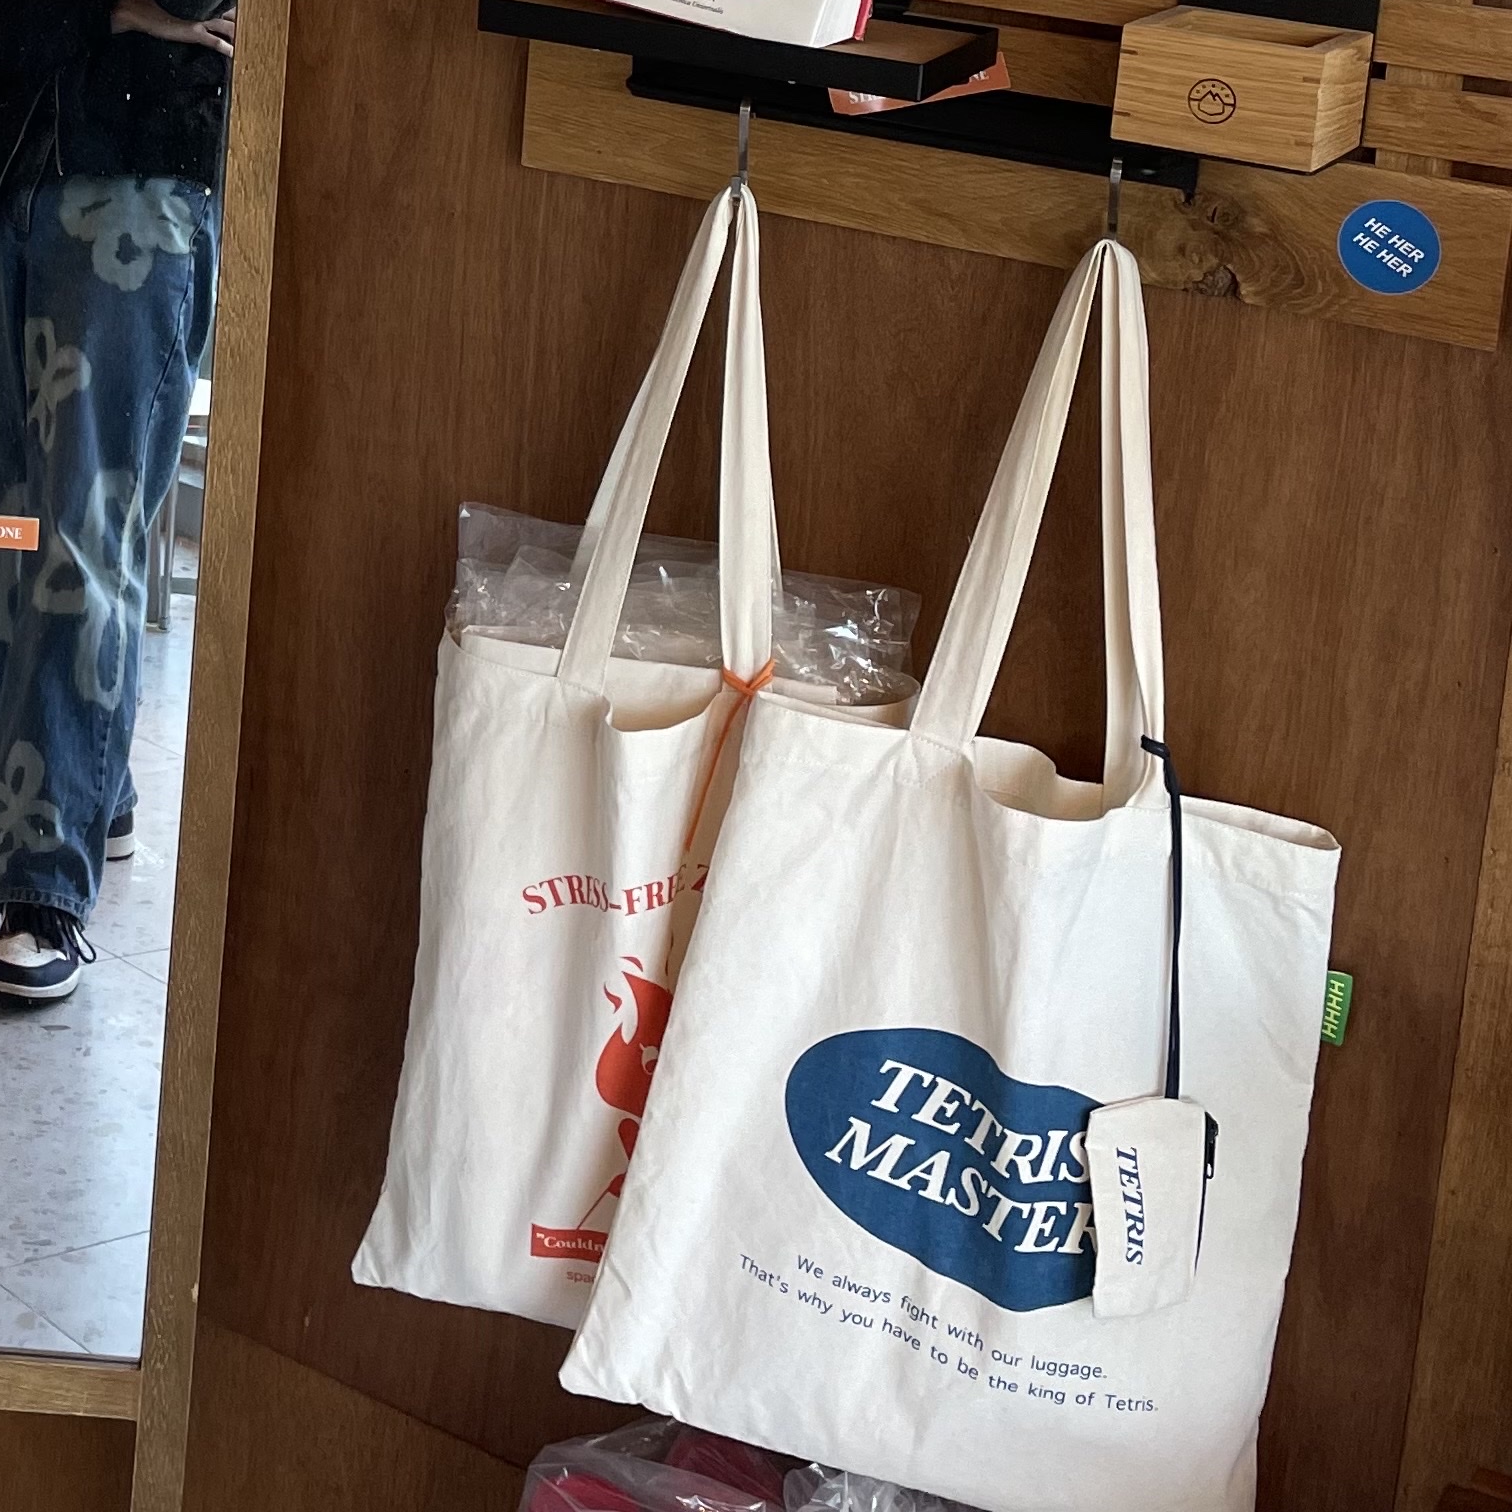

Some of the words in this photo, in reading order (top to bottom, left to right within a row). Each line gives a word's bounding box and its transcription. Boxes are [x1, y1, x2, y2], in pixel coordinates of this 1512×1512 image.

[1352, 232, 1380, 254] HE
[1376, 249, 1413, 278] HER
[1364, 217, 1392, 239] HE
[1387, 234, 1425, 263] HER
[1321, 979, 1345, 1039] HHHH
[871, 1059, 1089, 1185] TETRIS
[1116, 1146, 1145, 1265] TETRIS
[740, 1254, 789, 1294] That's
[797, 1289, 833, 1315] why
[839, 1309, 874, 1328] you
[882, 1318, 921, 1351] have
[930, 1346, 948, 1365] to
[957, 1357, 979, 1380] be
[988, 1375, 1018, 1394] the
[1028, 1383, 1066, 1405] king
[1075, 1392, 1096, 1406] of
[1105, 1394, 1159, 1412] Tetris.
[797, 1255, 824, 1279] We
[832, 1275, 891, 1303] always
[900, 1296, 938, 1329] fight
[947, 1324, 984, 1351] with
[991, 1349, 1022, 1367] our
[1031, 1355, 1107, 1380] luggage.
